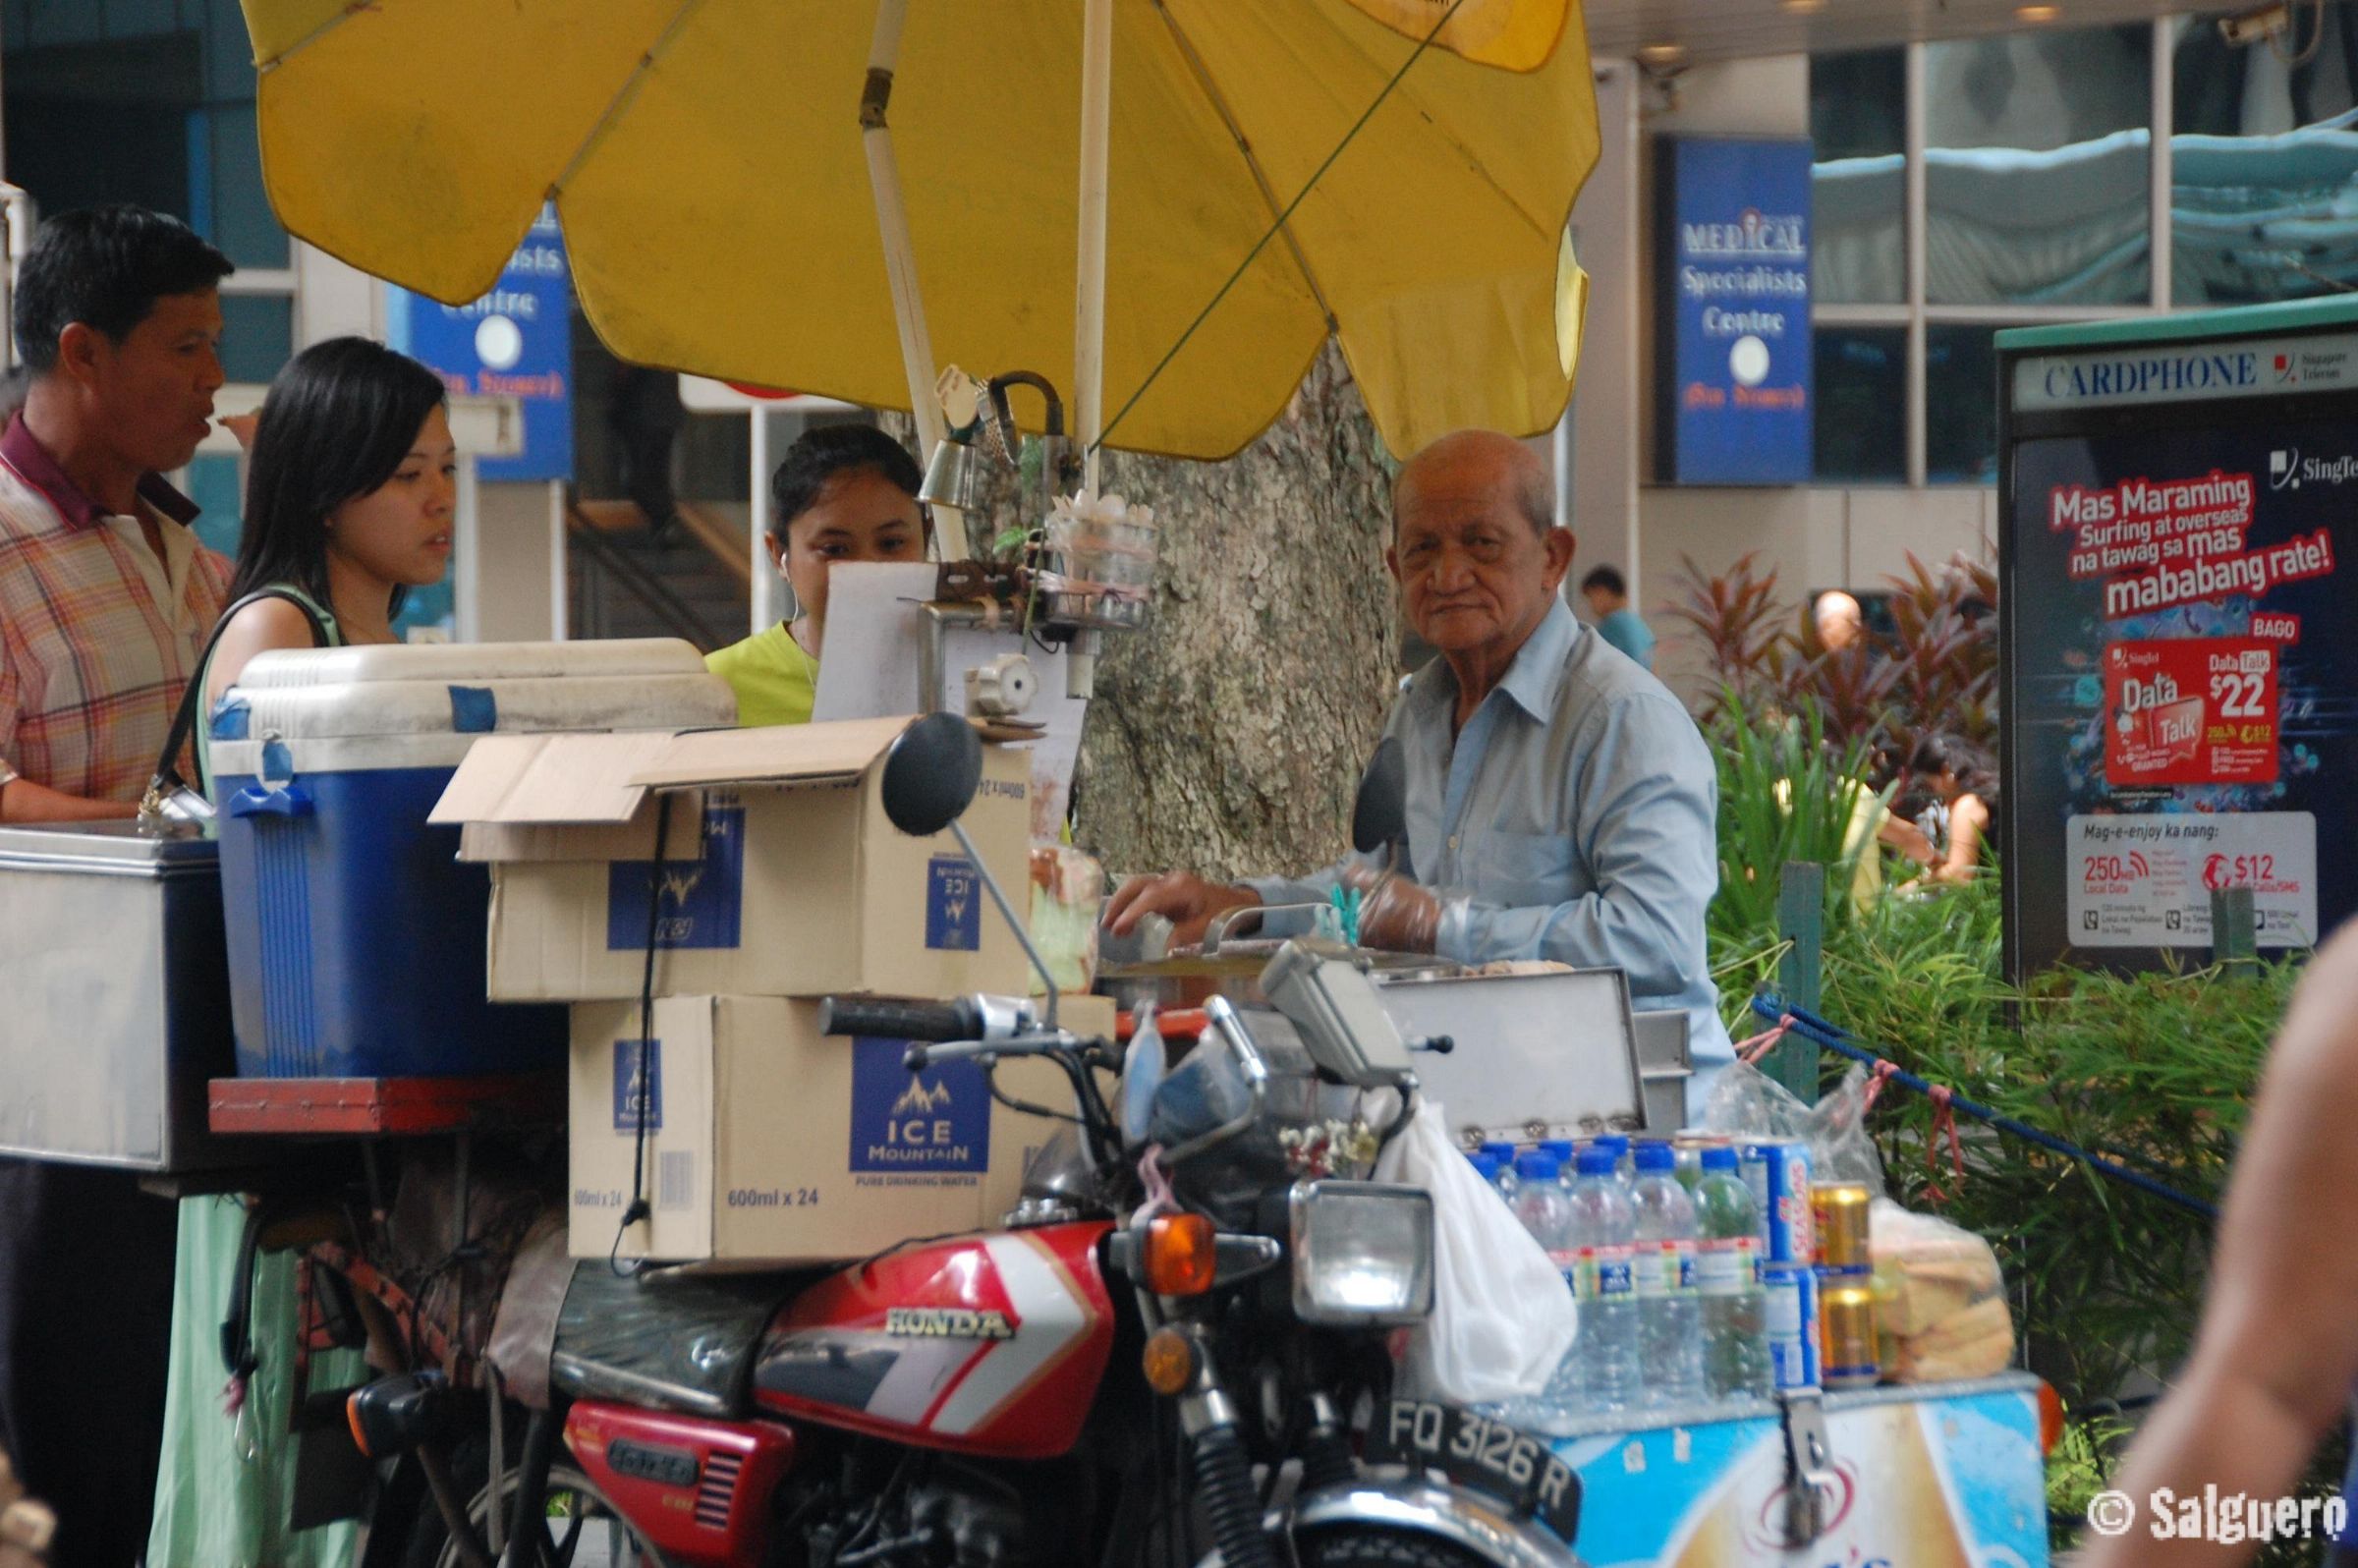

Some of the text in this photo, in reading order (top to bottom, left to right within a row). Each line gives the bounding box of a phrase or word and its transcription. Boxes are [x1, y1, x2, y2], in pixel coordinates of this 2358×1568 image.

[1683, 217, 1805, 252] MEDICAL
[1682, 265, 1807, 297] Specialists
[1703, 307, 1784, 333] Centre
[2045, 352, 2257, 398] CARDPHONE
[2053, 475, 2251, 525] Mas Maraming
[2080, 506, 2248, 547] Surfing at overseas
[2072, 527, 2242, 574] na tawag sa mas
[2107, 534, 2330, 615] mababang rate!
[2253, 619, 2296, 639] BAGO
[2210, 650, 2270, 672] Data Talk
[2123, 672, 2178, 713] Data
[2211, 674, 2266, 718] $22
[2161, 714, 2197, 746] Talk
[2084, 823, 2219, 842] Mag-e-enjoy ka nang:
[2234, 855, 2274, 881] $12
[944, 877, 970, 895] ICE
[888, 1120, 952, 1145] ICE
[869, 1146, 969, 1162] MOUNTAIN
[856, 1176, 978, 1187] PURE DRINKING WATER
[609, 1190, 622, 1207] 24
[728, 1187, 818, 1206] 600ml x 24
[886, 1308, 1013, 1337] HONDA
[1388, 1400, 1570, 1509] FQ 3126 R
